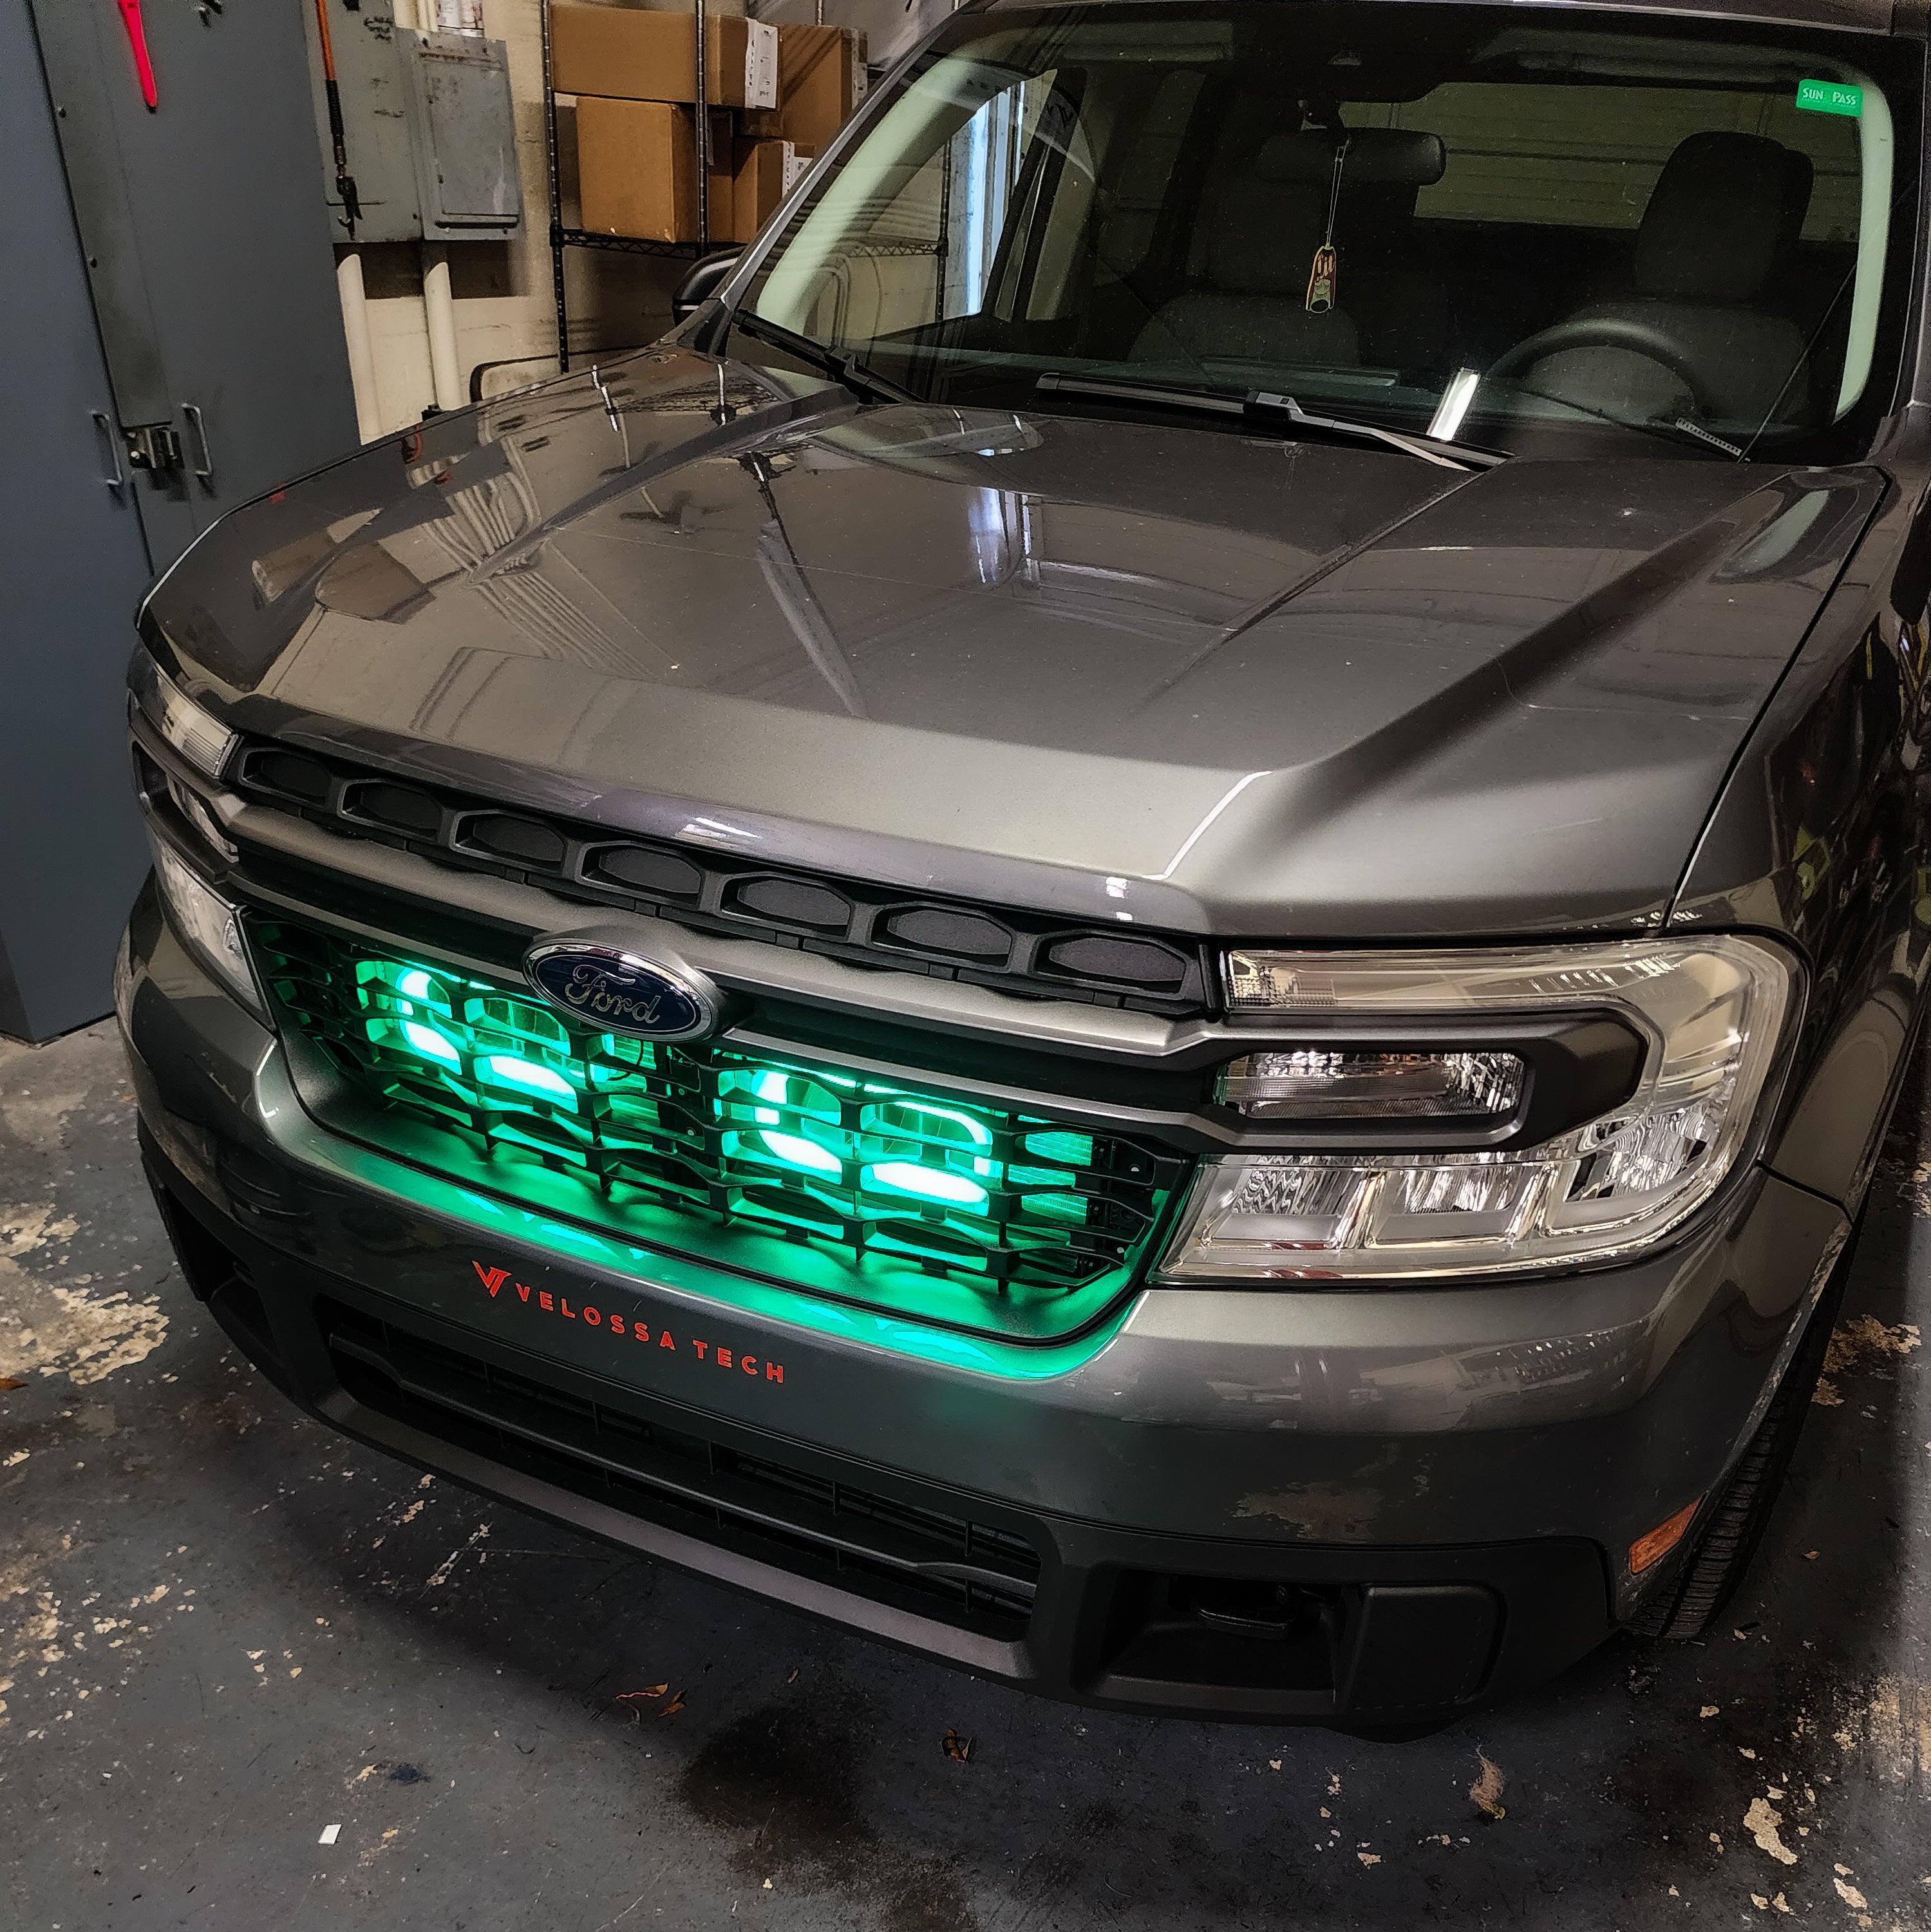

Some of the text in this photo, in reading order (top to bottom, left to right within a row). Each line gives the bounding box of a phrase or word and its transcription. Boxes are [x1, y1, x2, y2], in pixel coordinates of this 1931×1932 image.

[1802, 87, 1823, 100] SUN
[1832, 91, 1856, 105] PASS
[565, 964, 661, 1023] Ford
[515, 1282, 784, 1383] VELOSSA TECH
